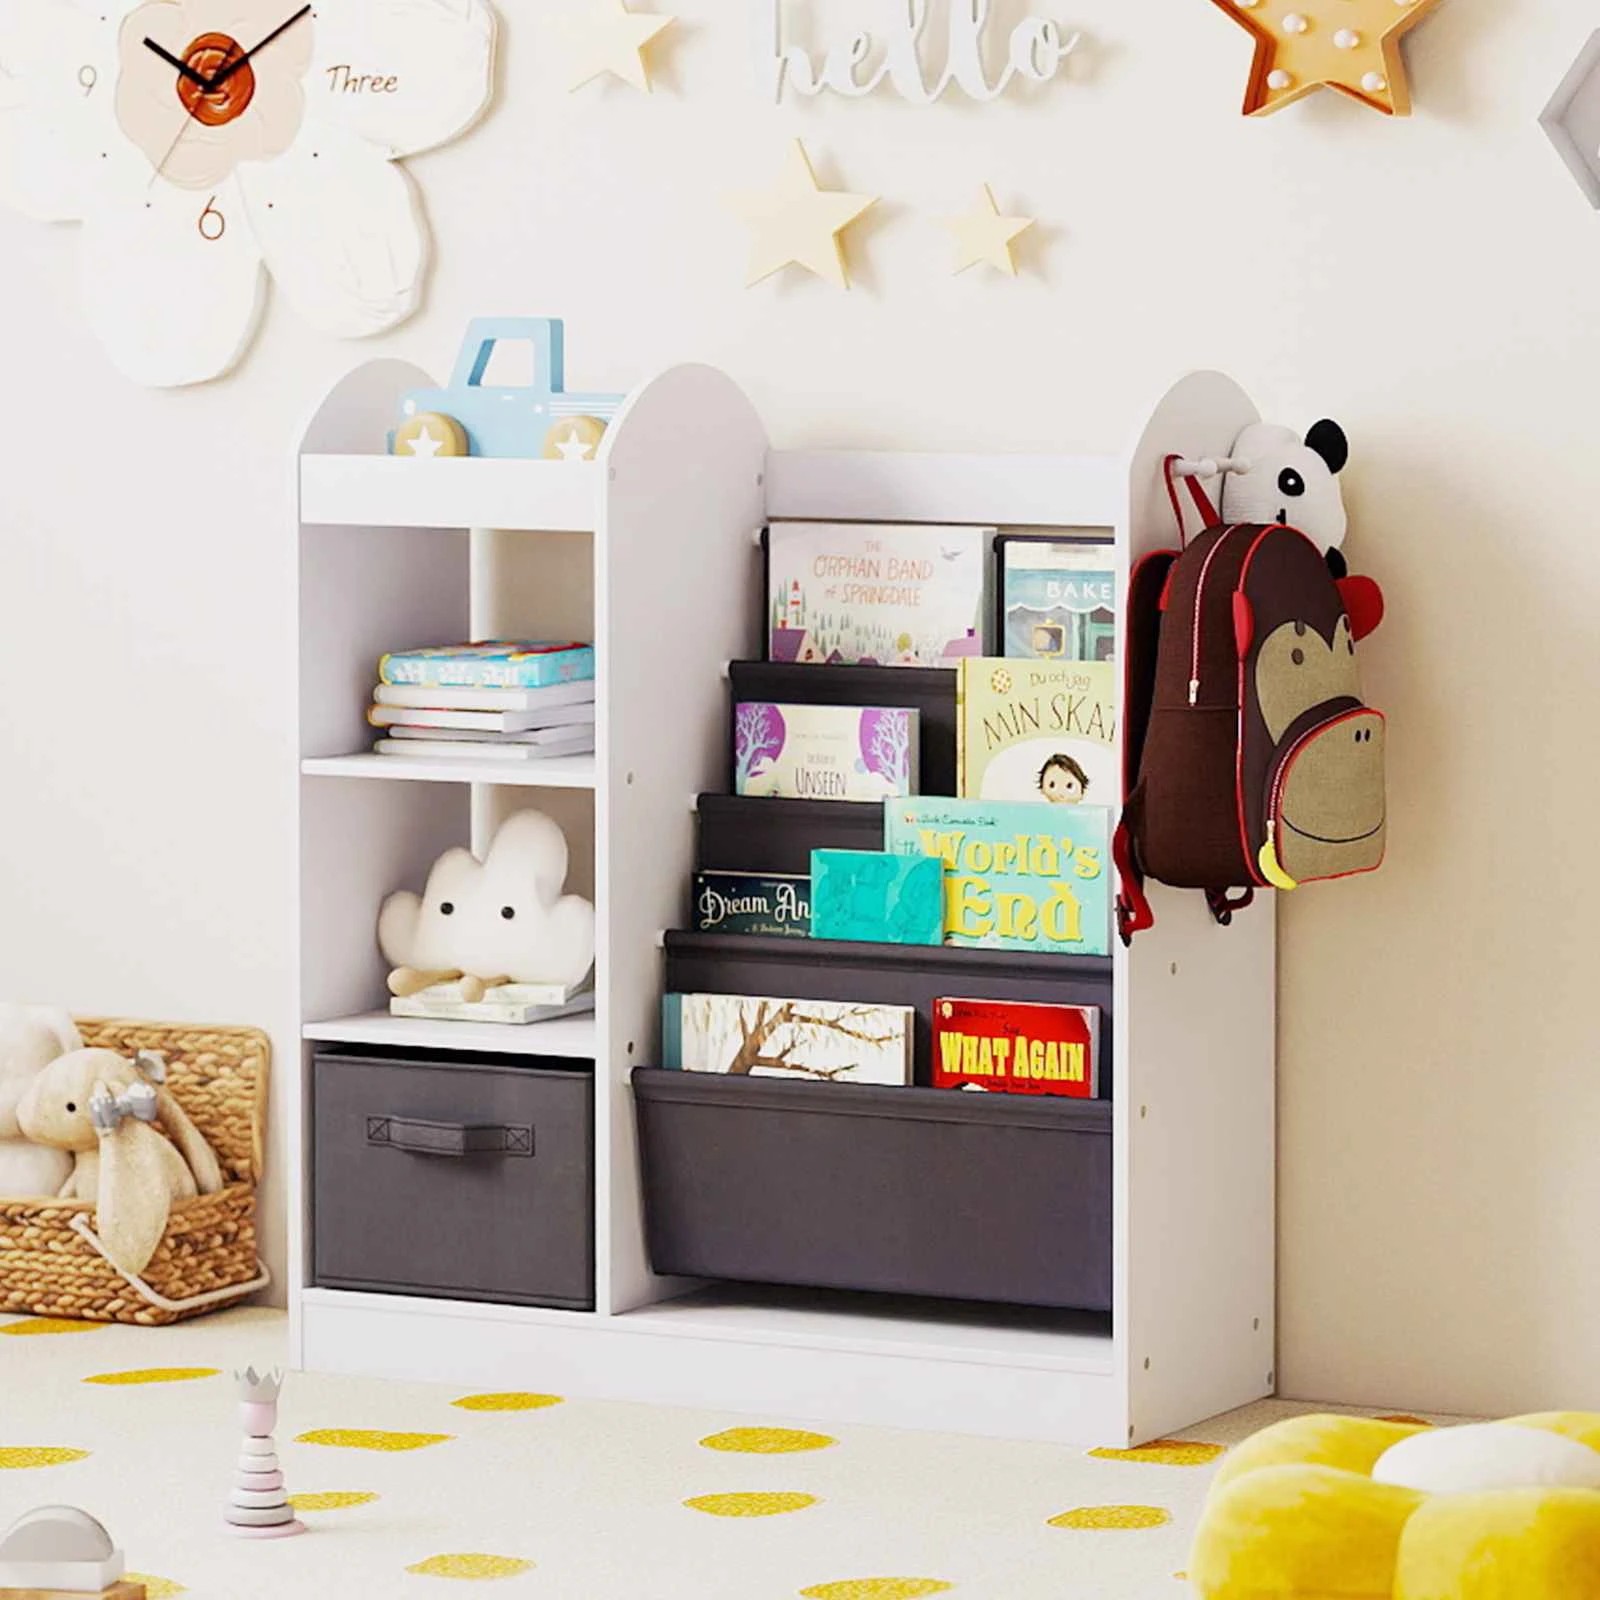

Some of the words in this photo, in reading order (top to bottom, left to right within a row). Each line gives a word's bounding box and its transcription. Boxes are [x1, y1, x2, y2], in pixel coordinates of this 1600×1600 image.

[758, 0, 1081, 104] hello
[78, 64, 97, 97] 9
[325, 64, 399, 94] Three
[198, 195, 226, 241] 6
[813, 555, 880, 578] ORPHAN
[887, 558, 934, 580] BAND
[841, 584, 921, 606] SPRINGDALE
[1046, 580, 1112, 600] BAKE
[983, 697, 1040, 750] MIN
[794, 767, 848, 796] UNSEEN
[918, 828, 1101, 880] World's
[699, 886, 771, 929] Dream
[943, 875, 1084, 943] End
[939, 1031, 1010, 1077] WHAT
[1012, 1035, 1085, 1082] AGAIN
